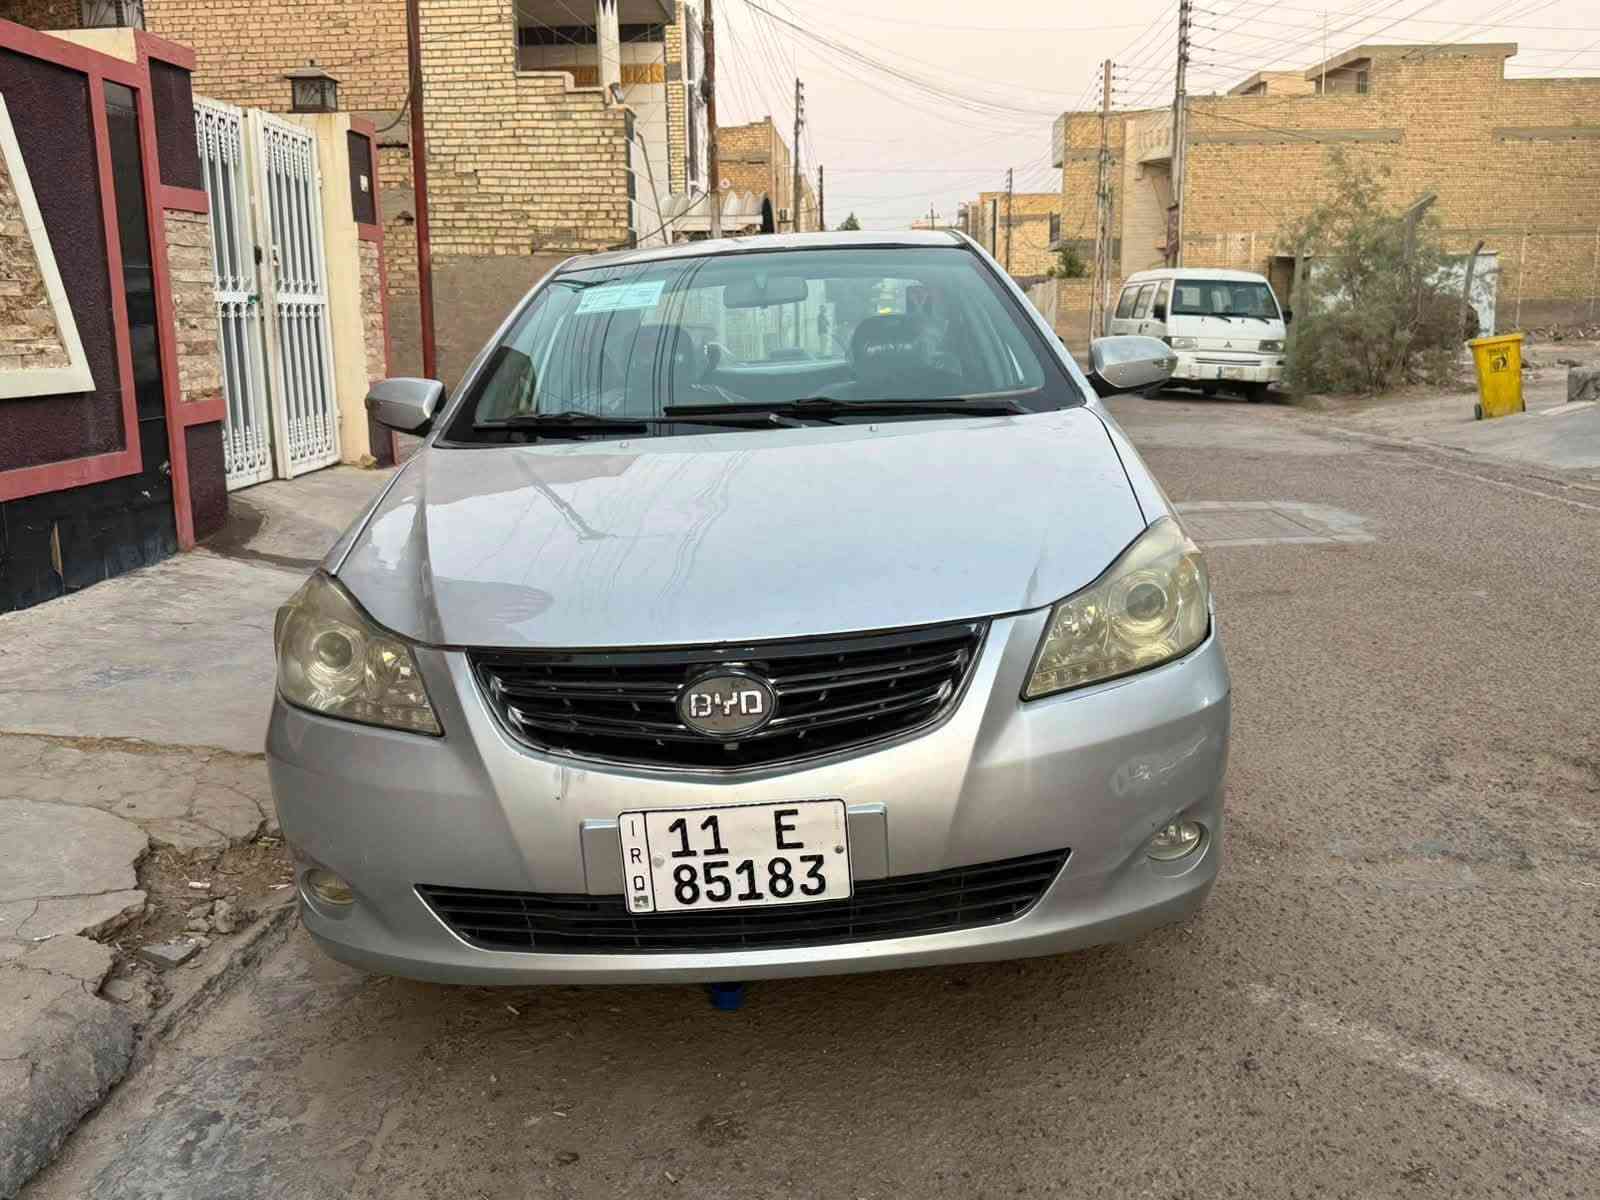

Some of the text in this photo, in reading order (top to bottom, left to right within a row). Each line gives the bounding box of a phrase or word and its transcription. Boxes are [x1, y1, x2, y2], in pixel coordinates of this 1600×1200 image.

[690, 689, 763, 717] BYD
[630, 819, 646, 891] IRQ
[668, 815, 729, 858] 11
[773, 808, 804, 850] E
[673, 853, 827, 905] 85183
